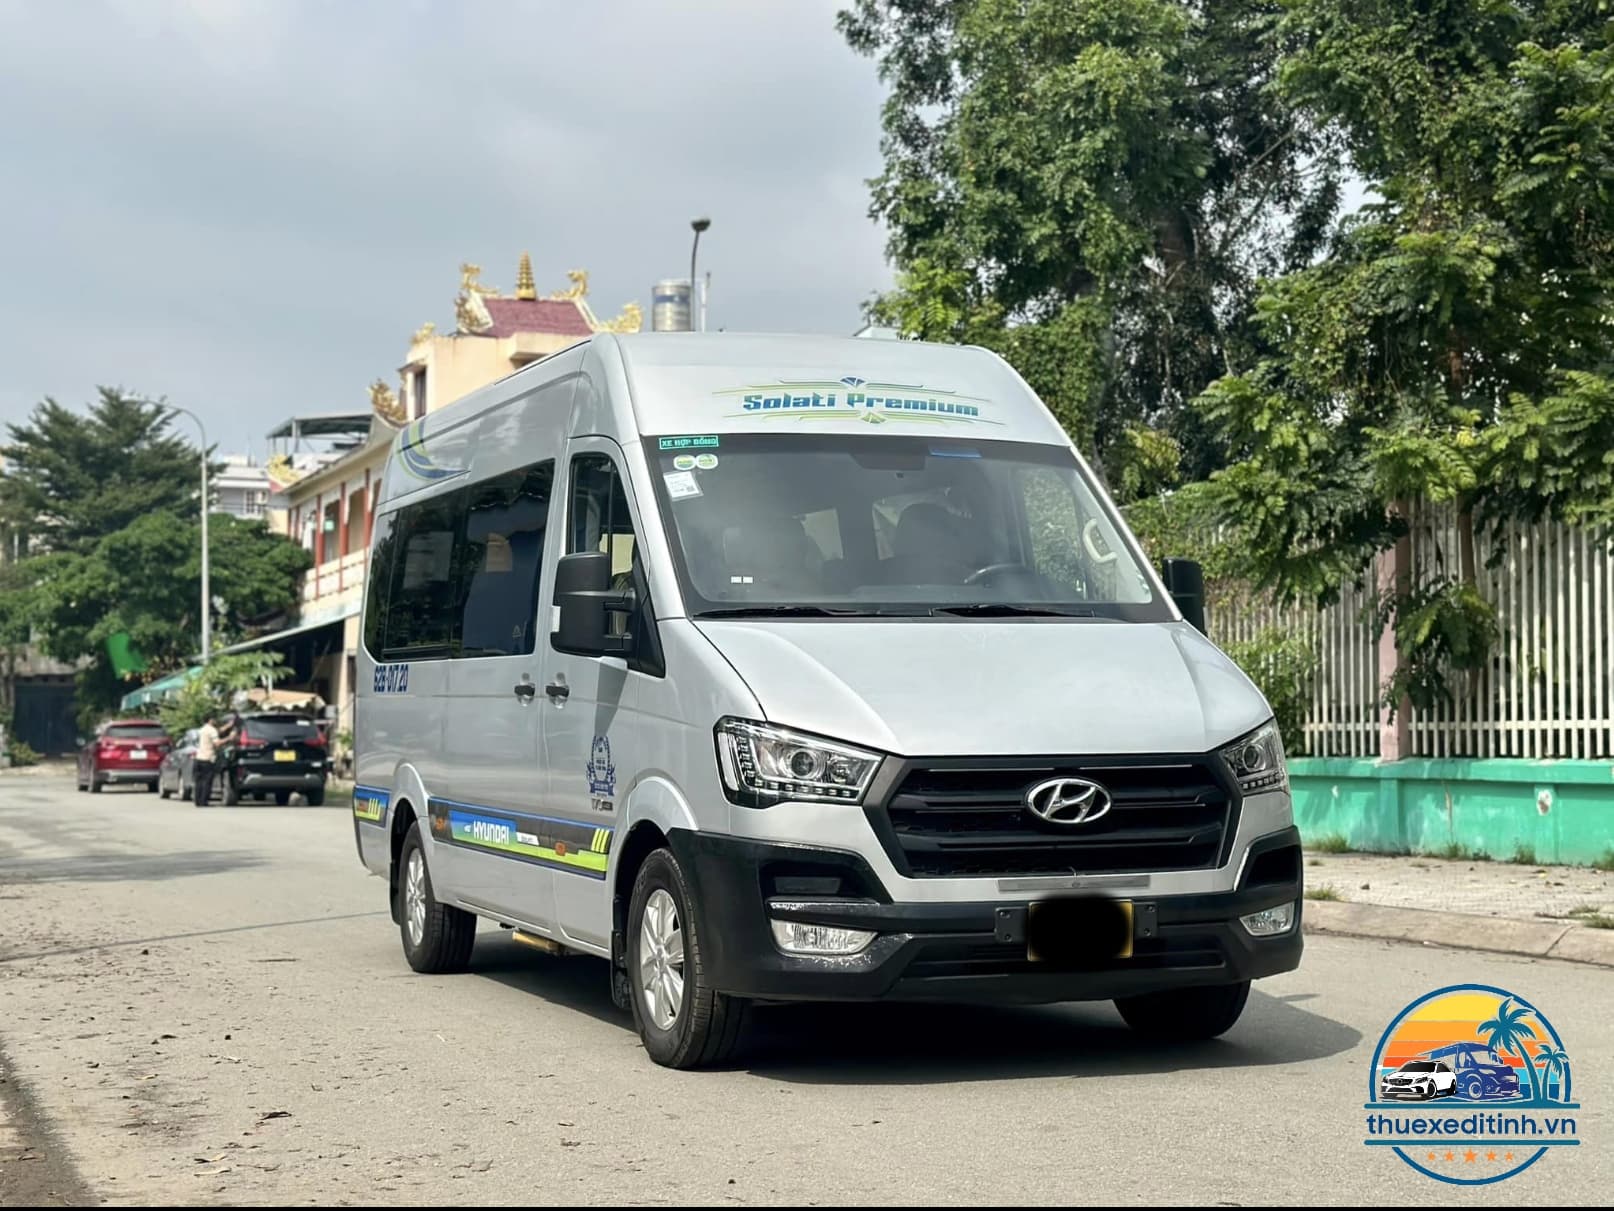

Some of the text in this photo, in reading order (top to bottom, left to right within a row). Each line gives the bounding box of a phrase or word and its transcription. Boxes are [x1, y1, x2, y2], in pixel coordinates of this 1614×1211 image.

[743, 391, 979, 416] Solati Premium
[473, 820, 510, 844] HYUNDAI
